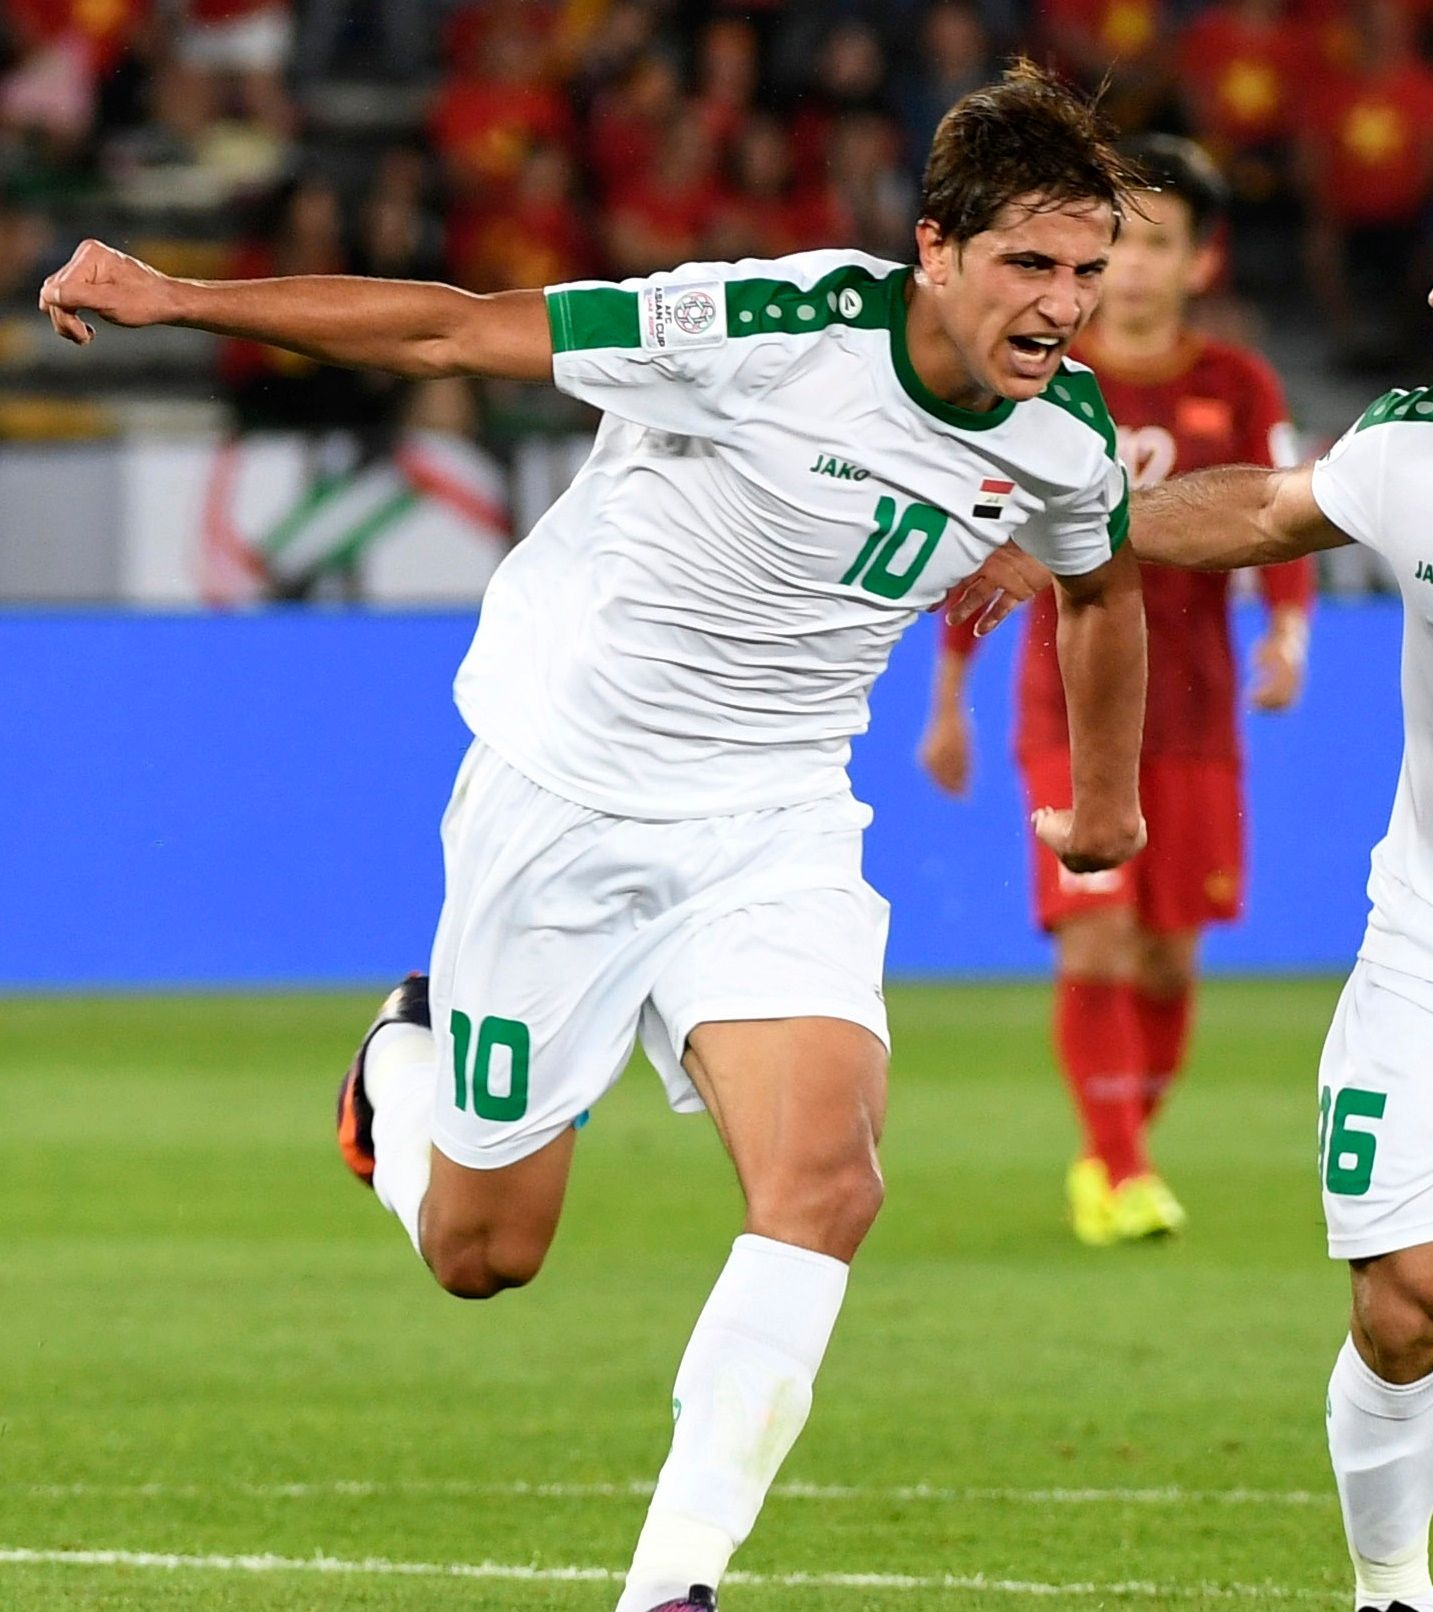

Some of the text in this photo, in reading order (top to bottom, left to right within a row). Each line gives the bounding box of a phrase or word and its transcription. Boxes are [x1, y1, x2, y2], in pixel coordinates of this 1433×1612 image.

[655, 287, 666, 347] ASIAN CUP
[809, 454, 871, 482] JAKO
[839, 495, 948, 600] 10
[449, 1008, 530, 1122] 10
